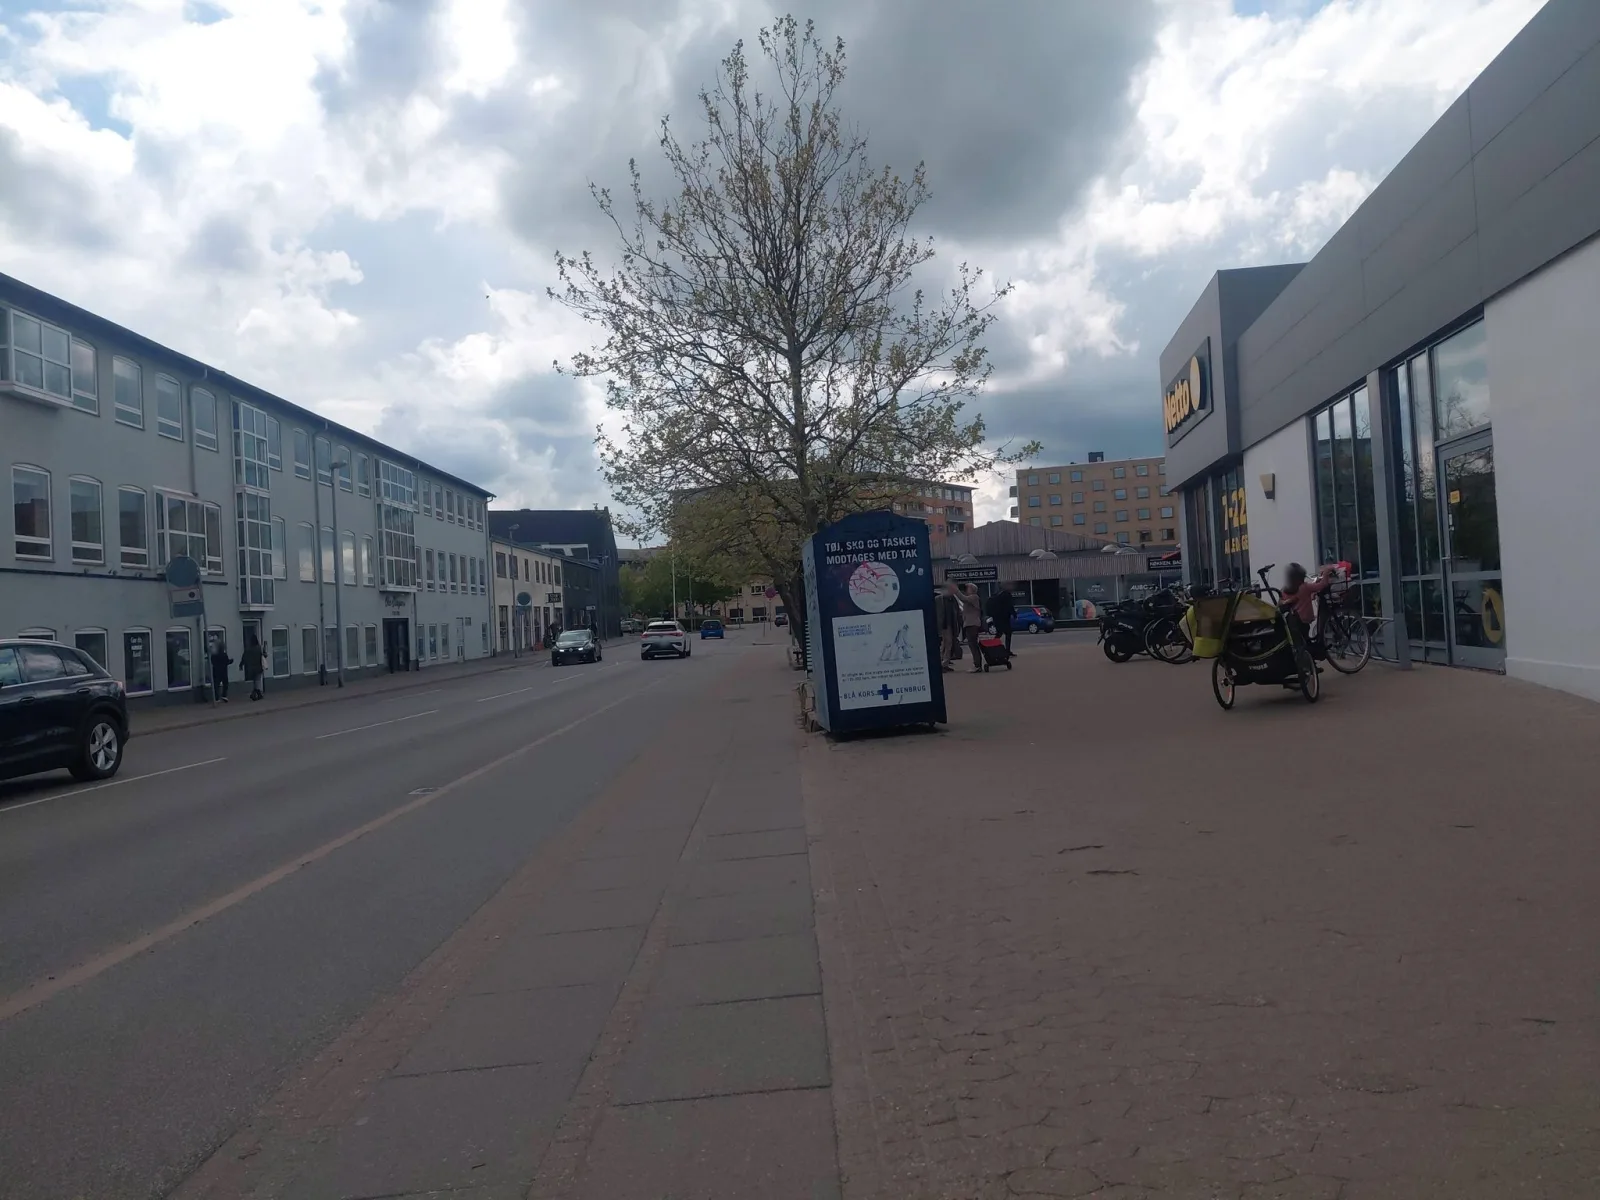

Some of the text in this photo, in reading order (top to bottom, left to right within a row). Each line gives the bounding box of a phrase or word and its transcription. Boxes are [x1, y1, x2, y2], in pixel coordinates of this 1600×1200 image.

[1164, 379, 1190, 433] Netto
[825, 536, 917, 553] TØJ, SKO OG TASKER
[826, 549, 918, 565] MODTAGES MED TAK
[844, 685, 926, 700] BLÅ KORS GENBRUG
